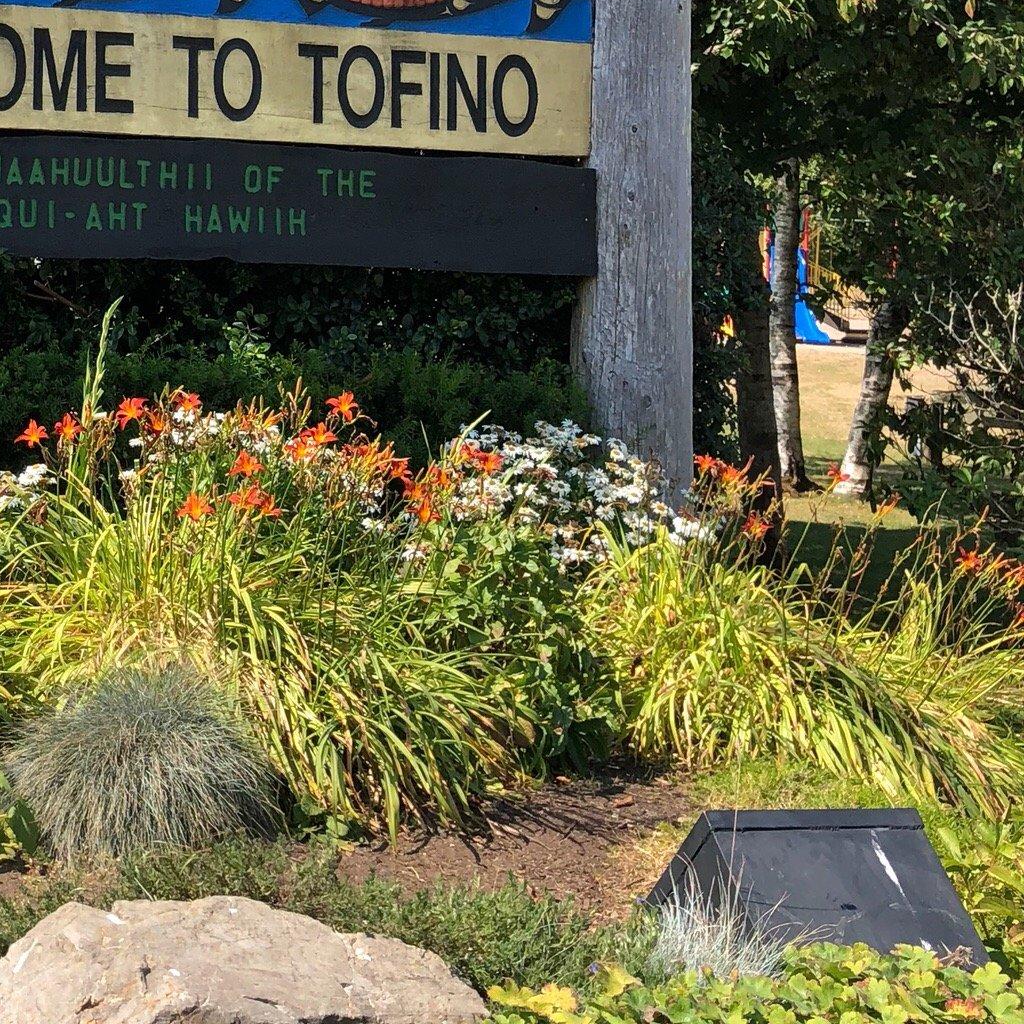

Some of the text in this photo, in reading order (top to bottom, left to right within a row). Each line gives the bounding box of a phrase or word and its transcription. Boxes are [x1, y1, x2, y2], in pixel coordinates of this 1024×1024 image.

[173, 34, 263, 122] TO
[298, 41, 539, 138] TOFINO
[243, 164, 284, 194] OF
[316, 168, 376, 198] THE
[184, 204, 307, 236] HAWIIH
